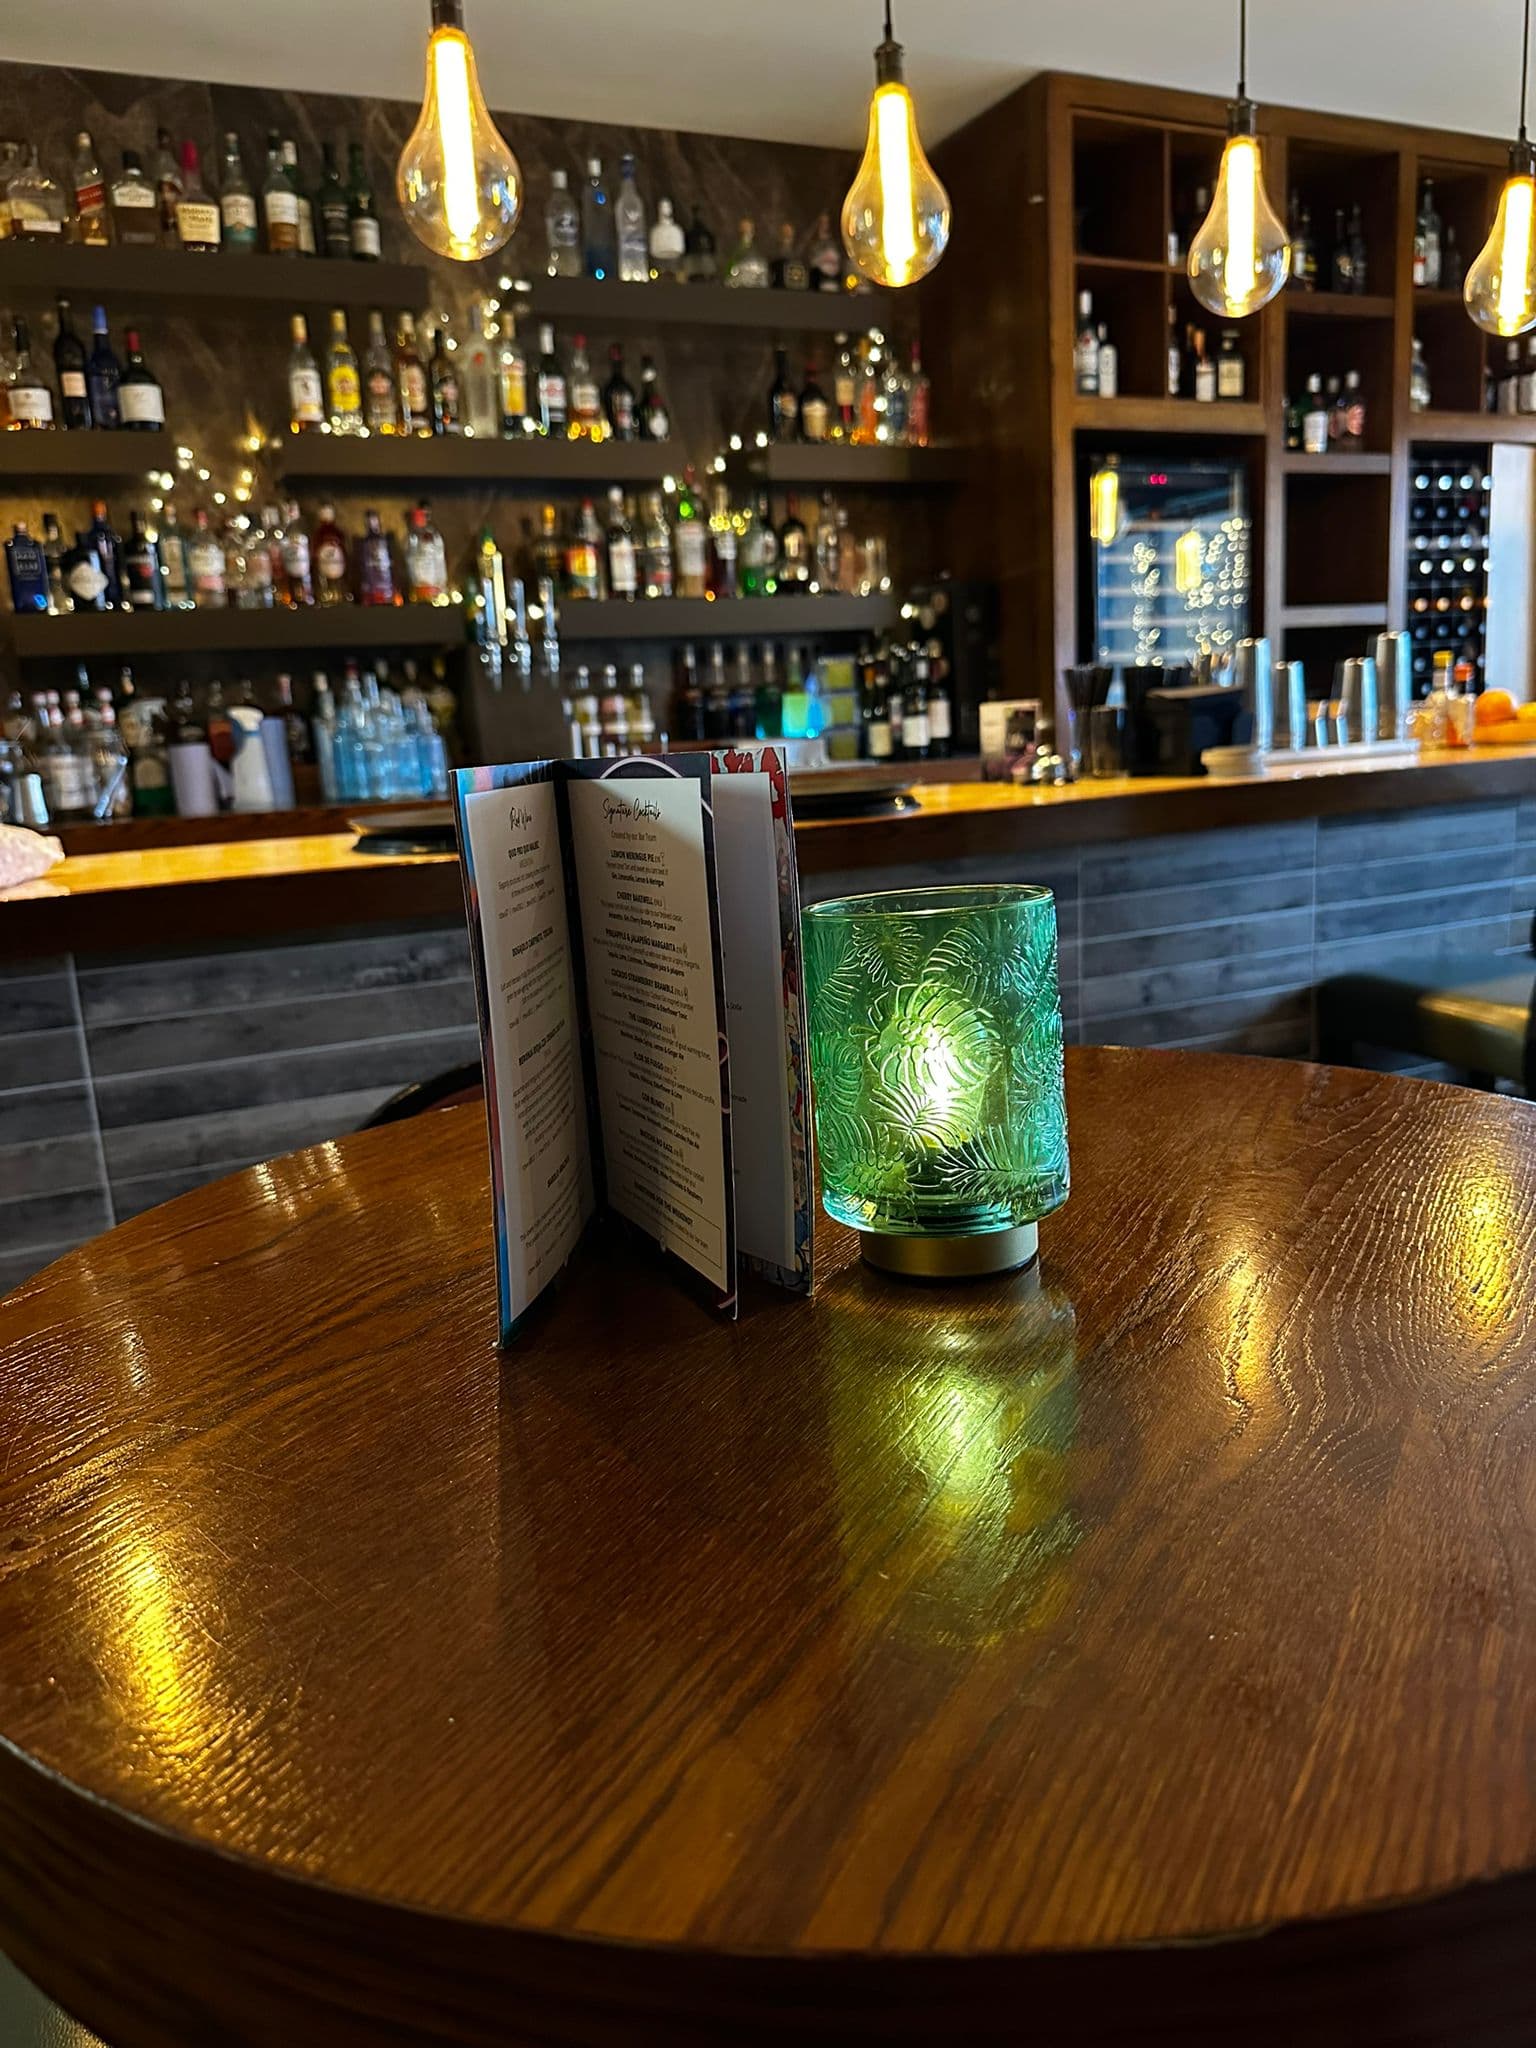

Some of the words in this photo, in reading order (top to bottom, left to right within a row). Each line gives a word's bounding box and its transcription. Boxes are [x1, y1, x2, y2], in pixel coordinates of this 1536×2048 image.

[602, 798, 632, 824] Signature
[633, 798, 661, 823] Cocktails
[610, 830, 625, 839] Created
[611, 850, 625, 859] LEMON
[626, 851, 647, 861] MERINGUE
[617, 891, 631, 901] CHERRY
[652, 939, 676, 952] MARGARITA
[654, 981, 674, 994] BRAMBLE
